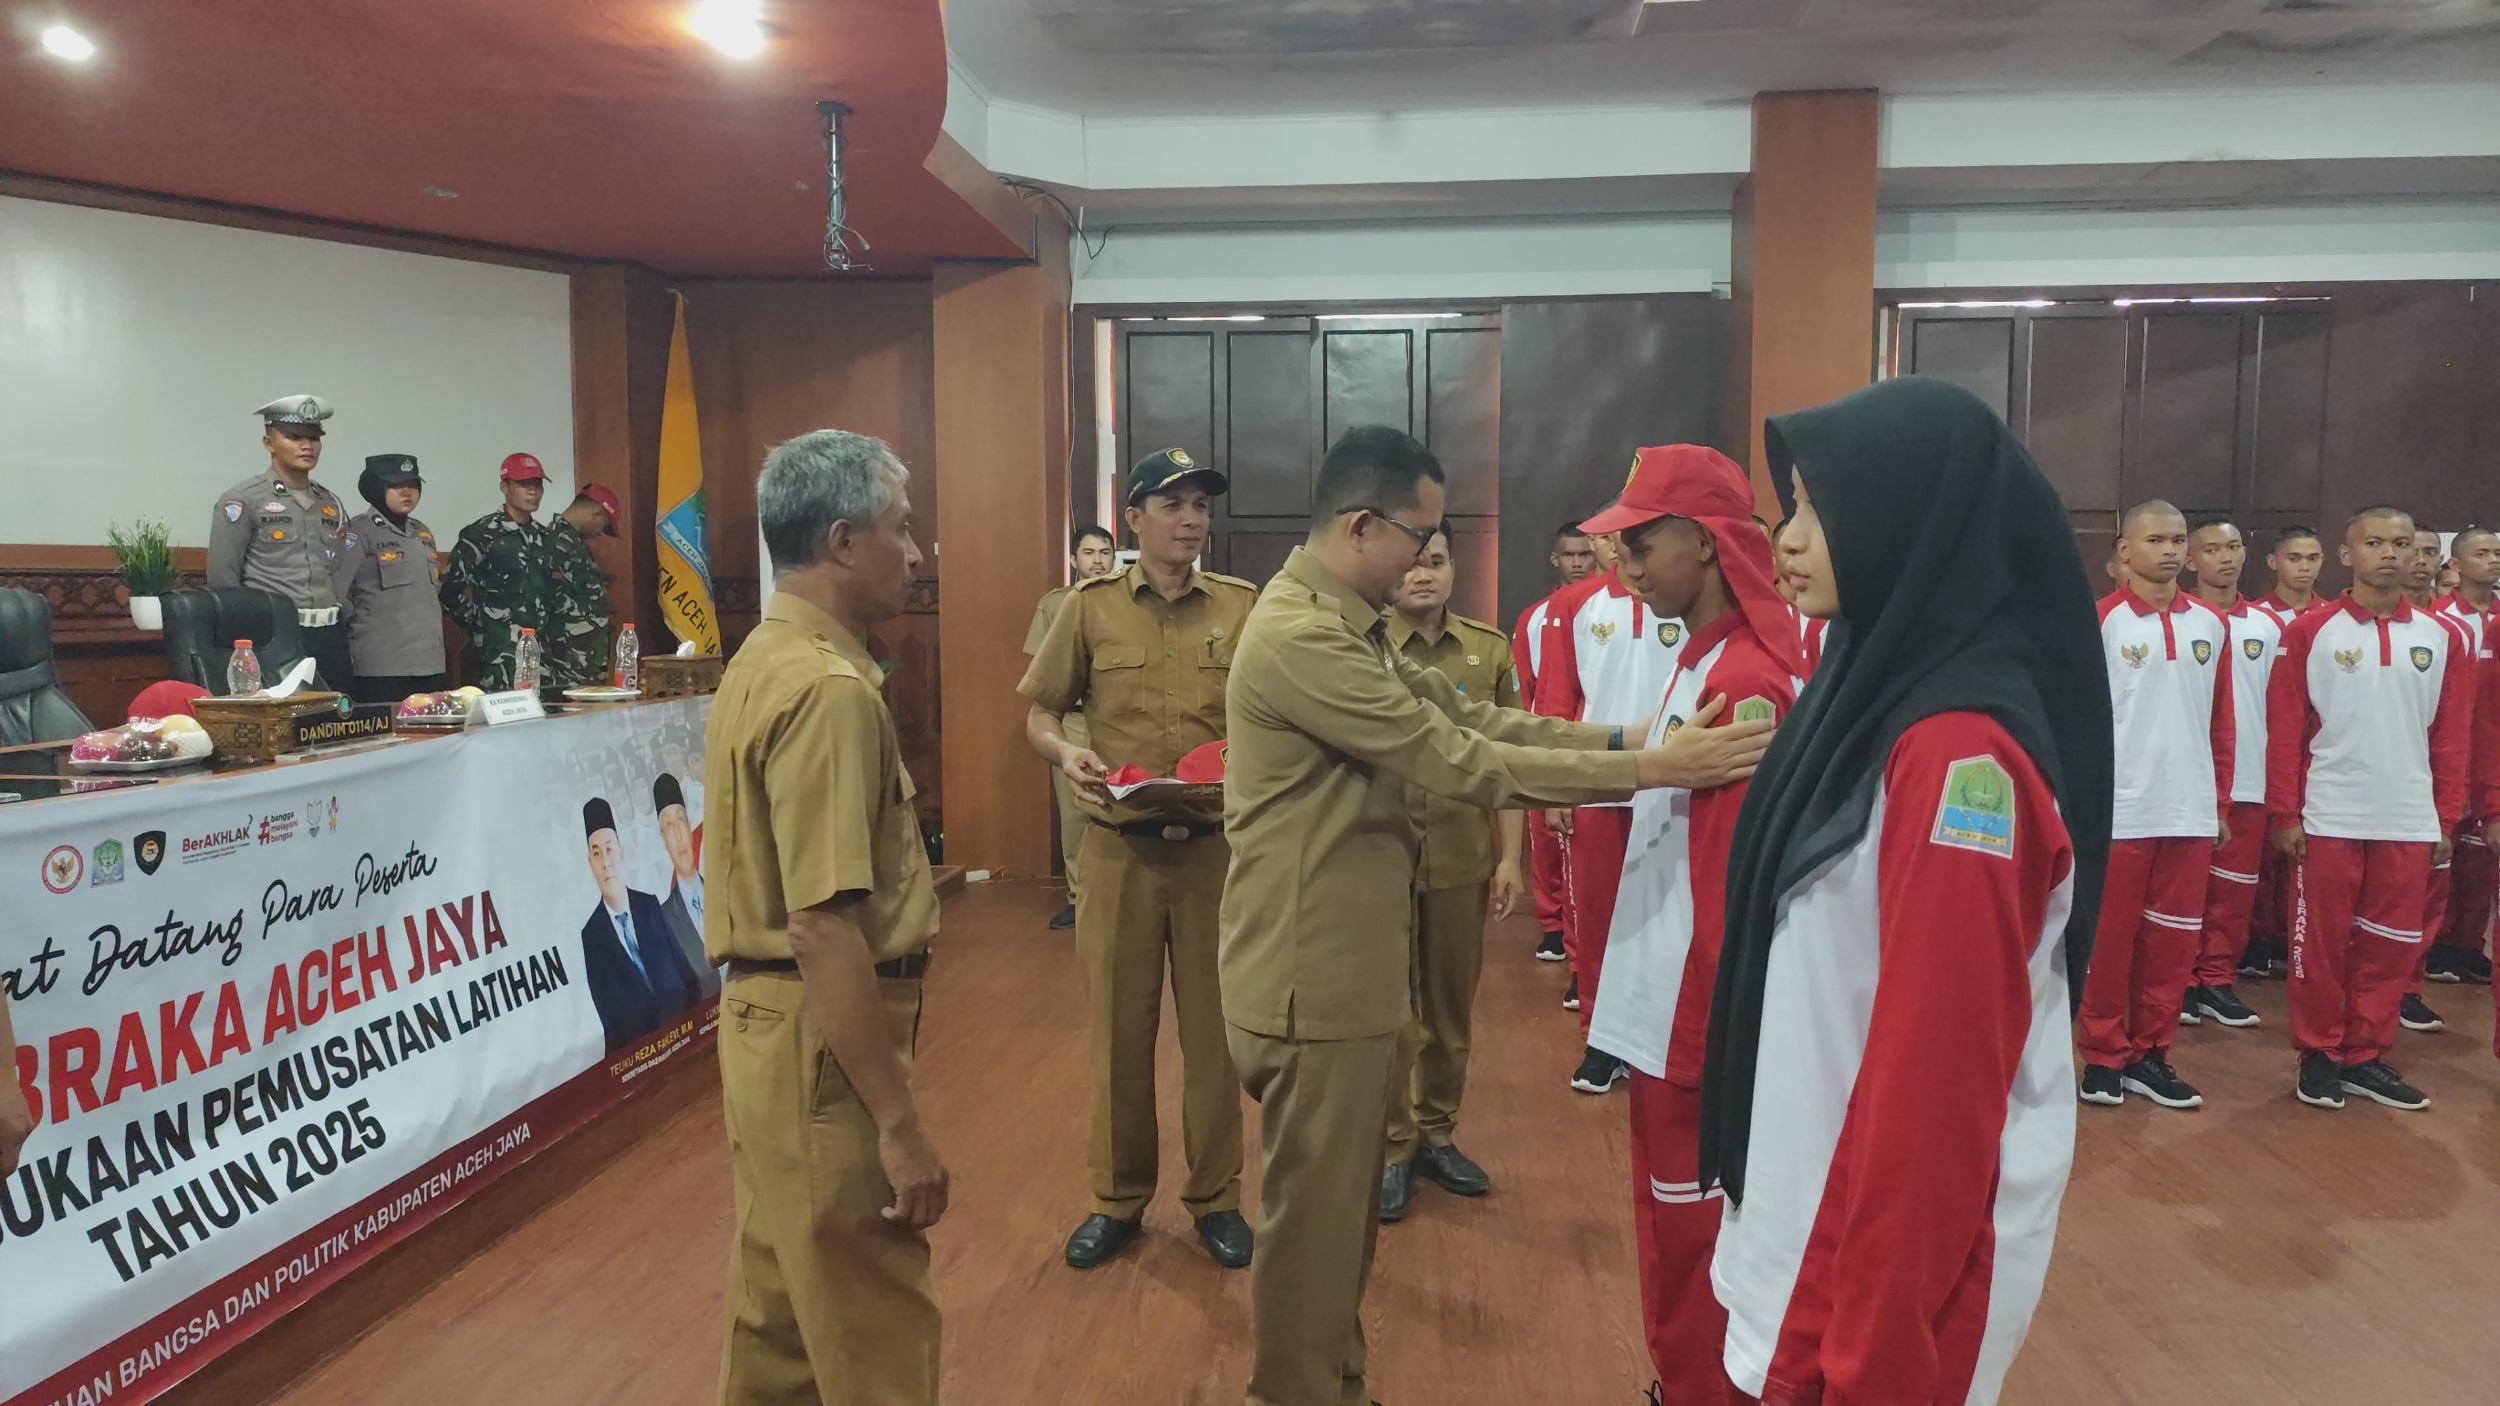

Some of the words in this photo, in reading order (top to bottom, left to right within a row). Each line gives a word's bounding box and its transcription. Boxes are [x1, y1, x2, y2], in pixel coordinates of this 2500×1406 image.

[677, 539, 698, 560] ACEH
[672, 591, 708, 635] ACEH
[301, 722, 346, 742] DANDIM
[348, 716, 389, 734] 0114/AJ
[182, 826, 250, 853] BerAKHLAK
[1980, 835, 1997, 843] JAYA
[82, 908, 244, 996] Datang
[262, 879, 344, 940] Para
[355, 840, 437, 908] Peserta
[263, 925, 398, 1046] ACEH
[403, 890, 508, 984] JAYA
[610, 1053, 634, 1077] TEUKU
[635, 1045, 656, 1062] REZA
[0, 1101, 196, 1247] UKAAN
[203, 996, 452, 1150] PEMUSATAN
[447, 946, 570, 1034] LATIHAN
[86, 1151, 279, 1283] TAHUN
[268, 1098, 387, 1194] 2025
[119, 1309, 221, 1388] BANGSA
[224, 1277, 270, 1324] DAN
[275, 1229, 350, 1294] POLITIK
[354, 1169, 451, 1245] KABUPATEN
[454, 1144, 493, 1185] ACEH
[496, 1122, 531, 1157] JAYA
